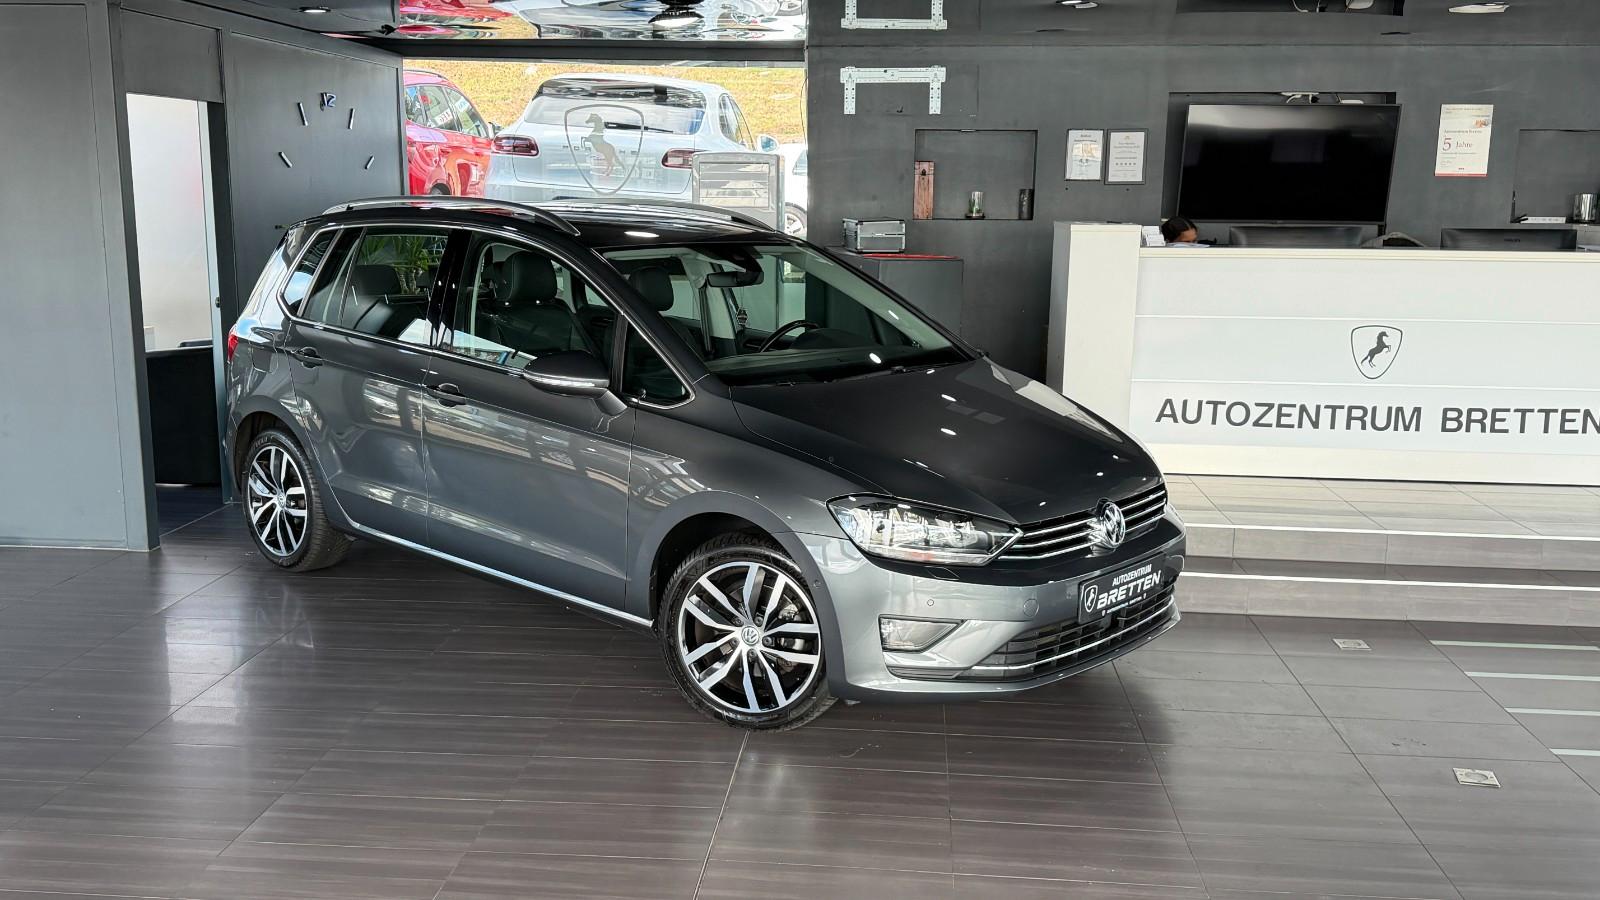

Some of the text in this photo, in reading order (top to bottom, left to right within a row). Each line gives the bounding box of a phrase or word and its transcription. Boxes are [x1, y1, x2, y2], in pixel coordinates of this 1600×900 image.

[1442, 136, 1452, 151] 5
[1156, 399, 1600, 433] AUTOZENTRUM BRETTEN
[1112, 564, 1152, 586] AUTOZENTRUM
[1097, 570, 1161, 609] BRETTEN
